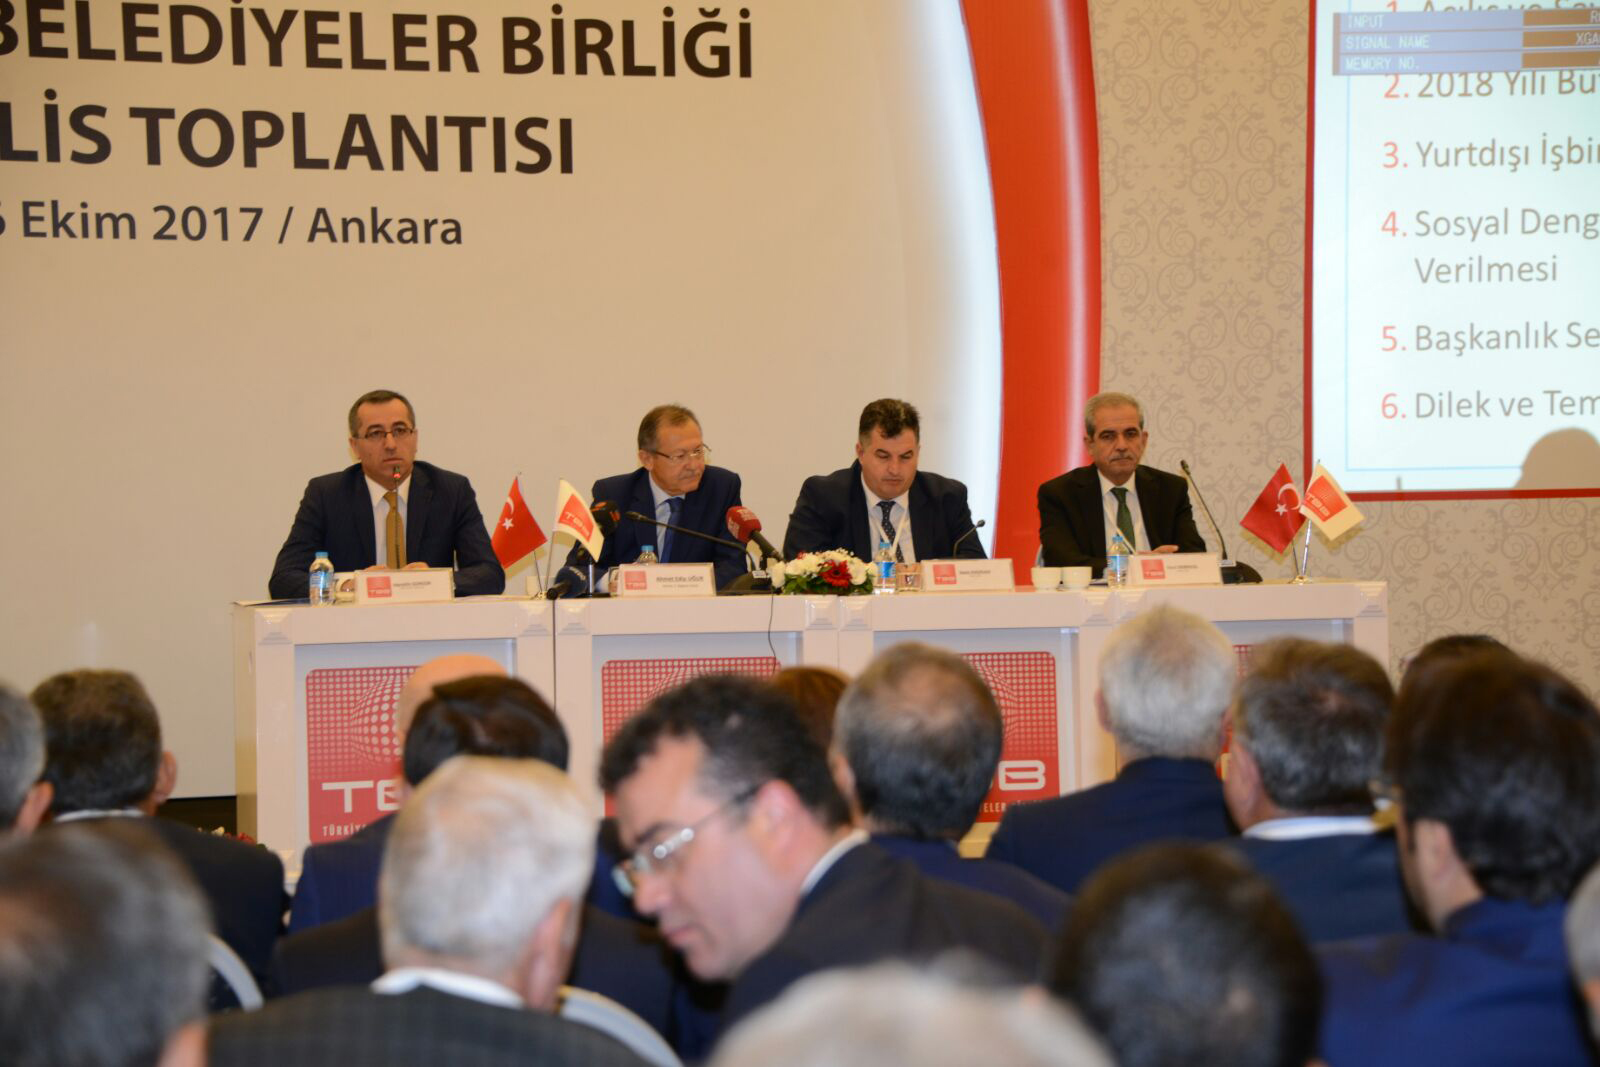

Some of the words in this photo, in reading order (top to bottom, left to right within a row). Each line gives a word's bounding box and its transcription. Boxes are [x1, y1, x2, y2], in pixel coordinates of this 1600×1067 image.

[1346, 15, 1384, 28] INPUT
[503, 4, 751, 77] BİRLİĞİ
[1346, 36, 1391, 49] SIGNAL
[1399, 35, 1430, 48] NAME
[1346, 57, 1391, 69] MEMORY
[1399, 56, 1419, 69] NO.
[1384, 73, 1409, 98] 2.
[1418, 72, 1493, 97] 2018
[1505, 71, 1545, 95] Yılı
[129, 107, 573, 174] TOPLANTISI
[1383, 141, 1408, 168] 3.
[1416, 138, 1529, 172] Yurtdışı
[22, 200, 136, 239] Ekim
[153, 206, 263, 242] 2017
[278, 207, 294, 244] /
[307, 207, 462, 244] Ankara
[1381, 211, 1407, 236] 4.
[1415, 208, 1509, 242] Sosyal
[1521, 208, 1600, 240] Deng
[1415, 254, 1557, 284] Verilmesi
[1381, 326, 1407, 351] 5.
[1416, 321, 1558, 356] Başkanlık
[1566, 322, 1600, 348] Se
[1381, 393, 1407, 419] 6.
[1416, 391, 1491, 418] Dilek
[1499, 397, 1534, 417] ve
